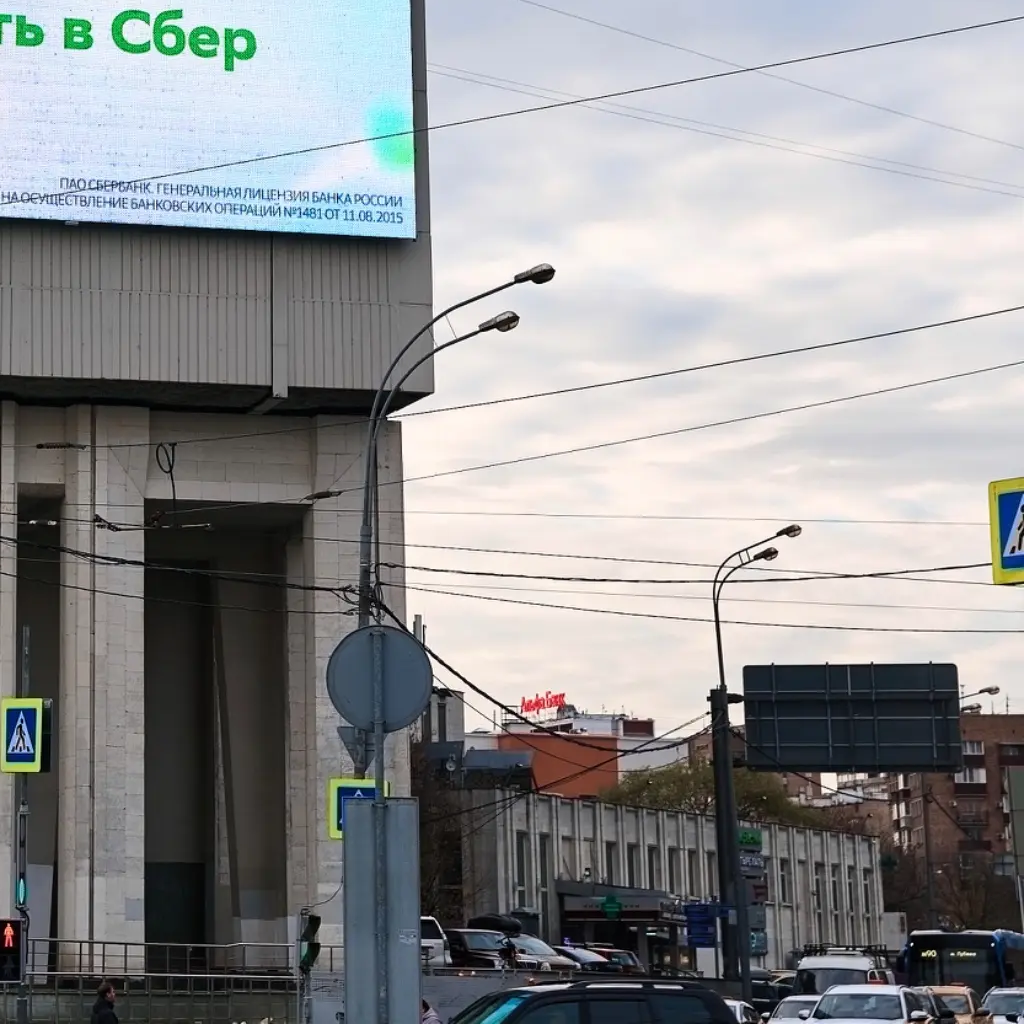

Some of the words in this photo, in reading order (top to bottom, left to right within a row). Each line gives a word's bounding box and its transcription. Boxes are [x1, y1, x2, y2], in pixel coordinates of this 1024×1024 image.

[63, 18, 95, 50] в
[111, 10, 258, 72] Сбер
[1, 191, 20, 204] НА
[21, 192, 129, 209] ОСУЩЕСТВЛЕНИЕ
[130, 198, 212, 213] БАНКОВСКИХ
[214, 202, 281, 219] ОПЕРАЦИЙ
[283, 207, 323, 220] №1481
[325, 209, 340, 220] ОТ
[343, 210, 404, 224] 11.08.2015
[60, 177, 87, 190] ПАО
[156, 182, 241, 198] ГЕНЕРАЛЬНАЯ
[243, 187, 310, 202] ЛИЦЕНЗИЯ
[311, 191, 352, 205] БАНКА
[354, 194, 402, 208] РОССИИ
